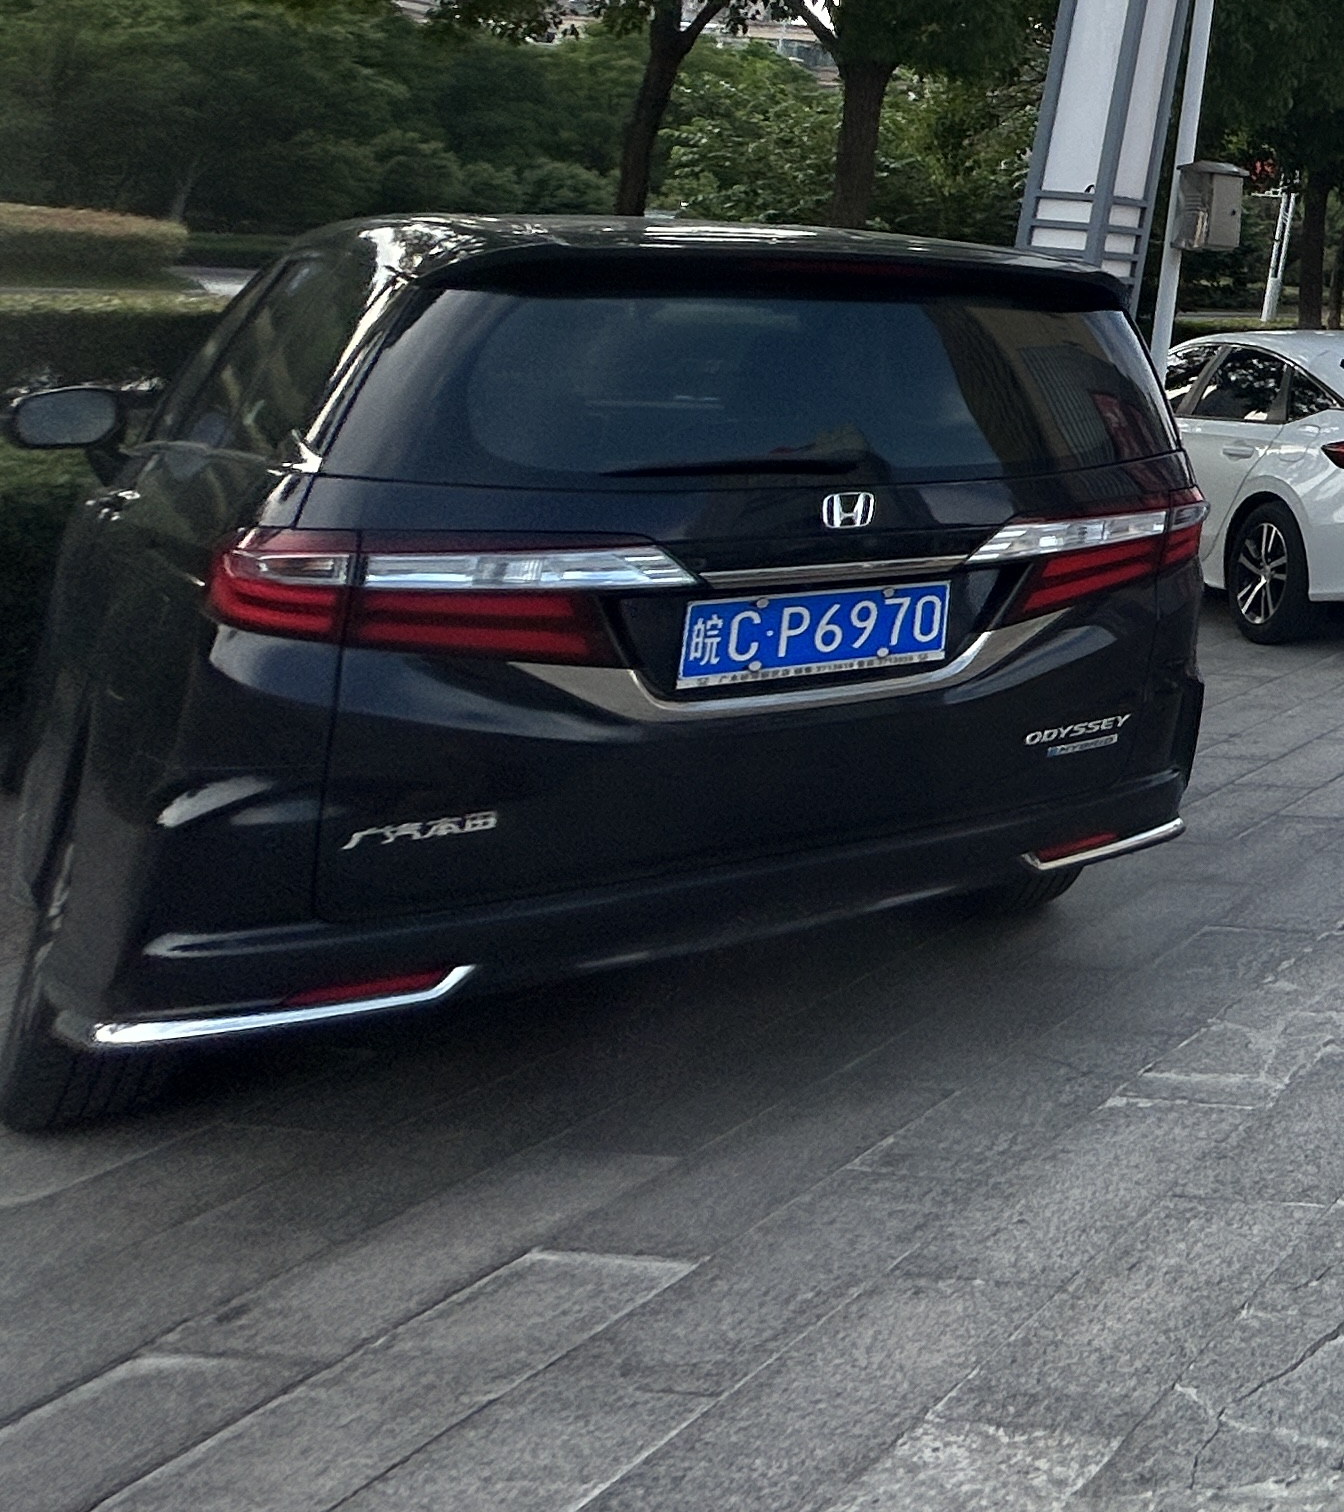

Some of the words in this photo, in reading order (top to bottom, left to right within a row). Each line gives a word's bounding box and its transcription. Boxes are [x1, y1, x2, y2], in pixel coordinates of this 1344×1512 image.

[688, 594, 943, 666] 皖C·P6970
[1025, 713, 1132, 745] ODYSSEY
[341, 811, 498, 850] 广汽本田
